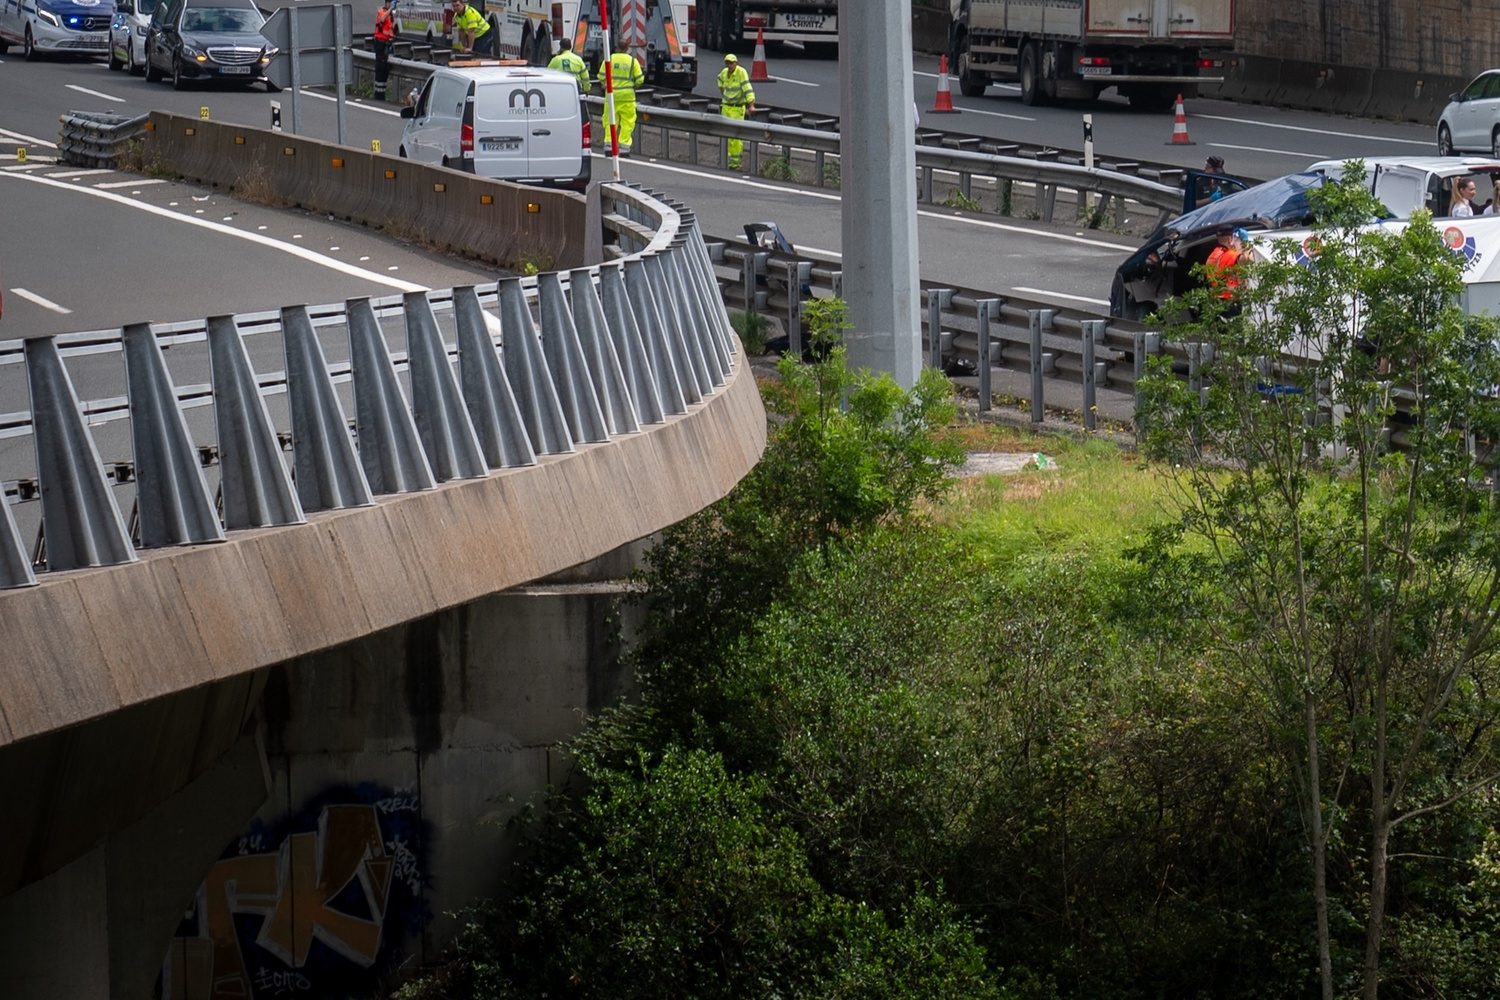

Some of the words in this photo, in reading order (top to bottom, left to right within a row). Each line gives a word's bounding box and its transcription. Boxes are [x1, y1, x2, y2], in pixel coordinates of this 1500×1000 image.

[787, 20, 824, 29] SCHMITZ
[201, 107, 209, 118] 22
[509, 106, 547, 116] mémora
